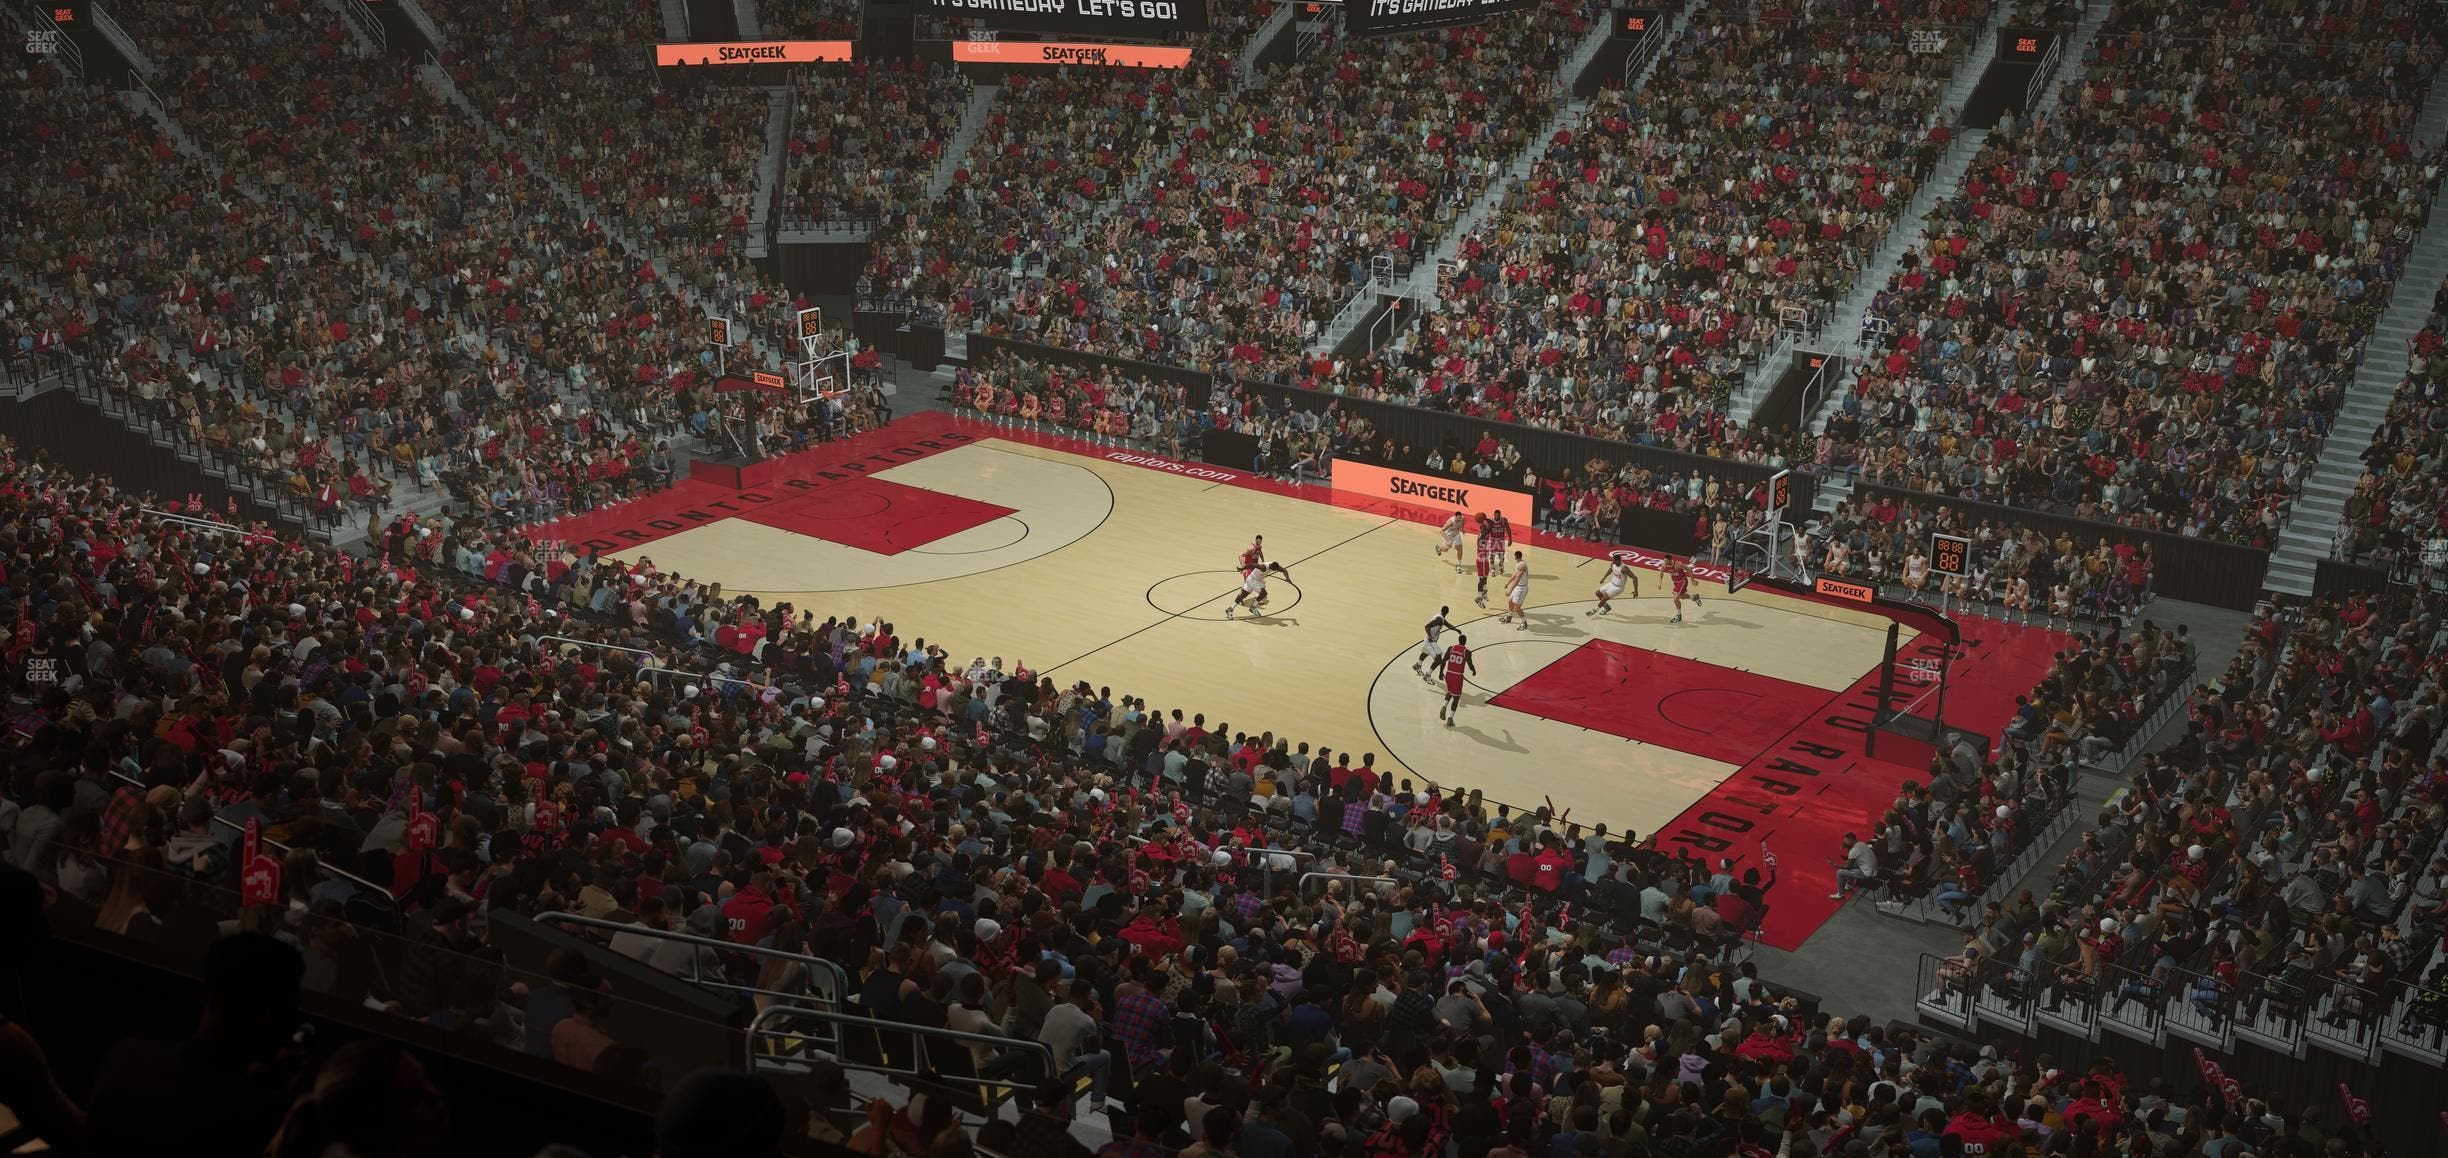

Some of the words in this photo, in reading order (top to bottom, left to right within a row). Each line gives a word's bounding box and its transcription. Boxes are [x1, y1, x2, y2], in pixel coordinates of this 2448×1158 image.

[1077, 0, 1135, 18] LET'S
[1140, 1, 1178, 20] GO!
[1370, 0, 1400, 17] IT'S
[719, 45, 786, 60] SEATGEEK
[1043, 46, 1107, 62] SEATGEEK
[1104, 451, 1237, 483] raptors.com
[575, 492, 773, 558] ORONTO
[783, 433, 974, 490] RAPTORS
[1390, 476, 1469, 508] SEATGEEK
[1609, 550, 1731, 580] @raors
[1939, 552, 1958, 571] 88
[1822, 581, 1866, 599] SEATGEEK
[1449, 654, 1464, 665] 00
[1660, 740, 1846, 855] RAPTOR
[1964, 1142, 1984, 1154] 00
